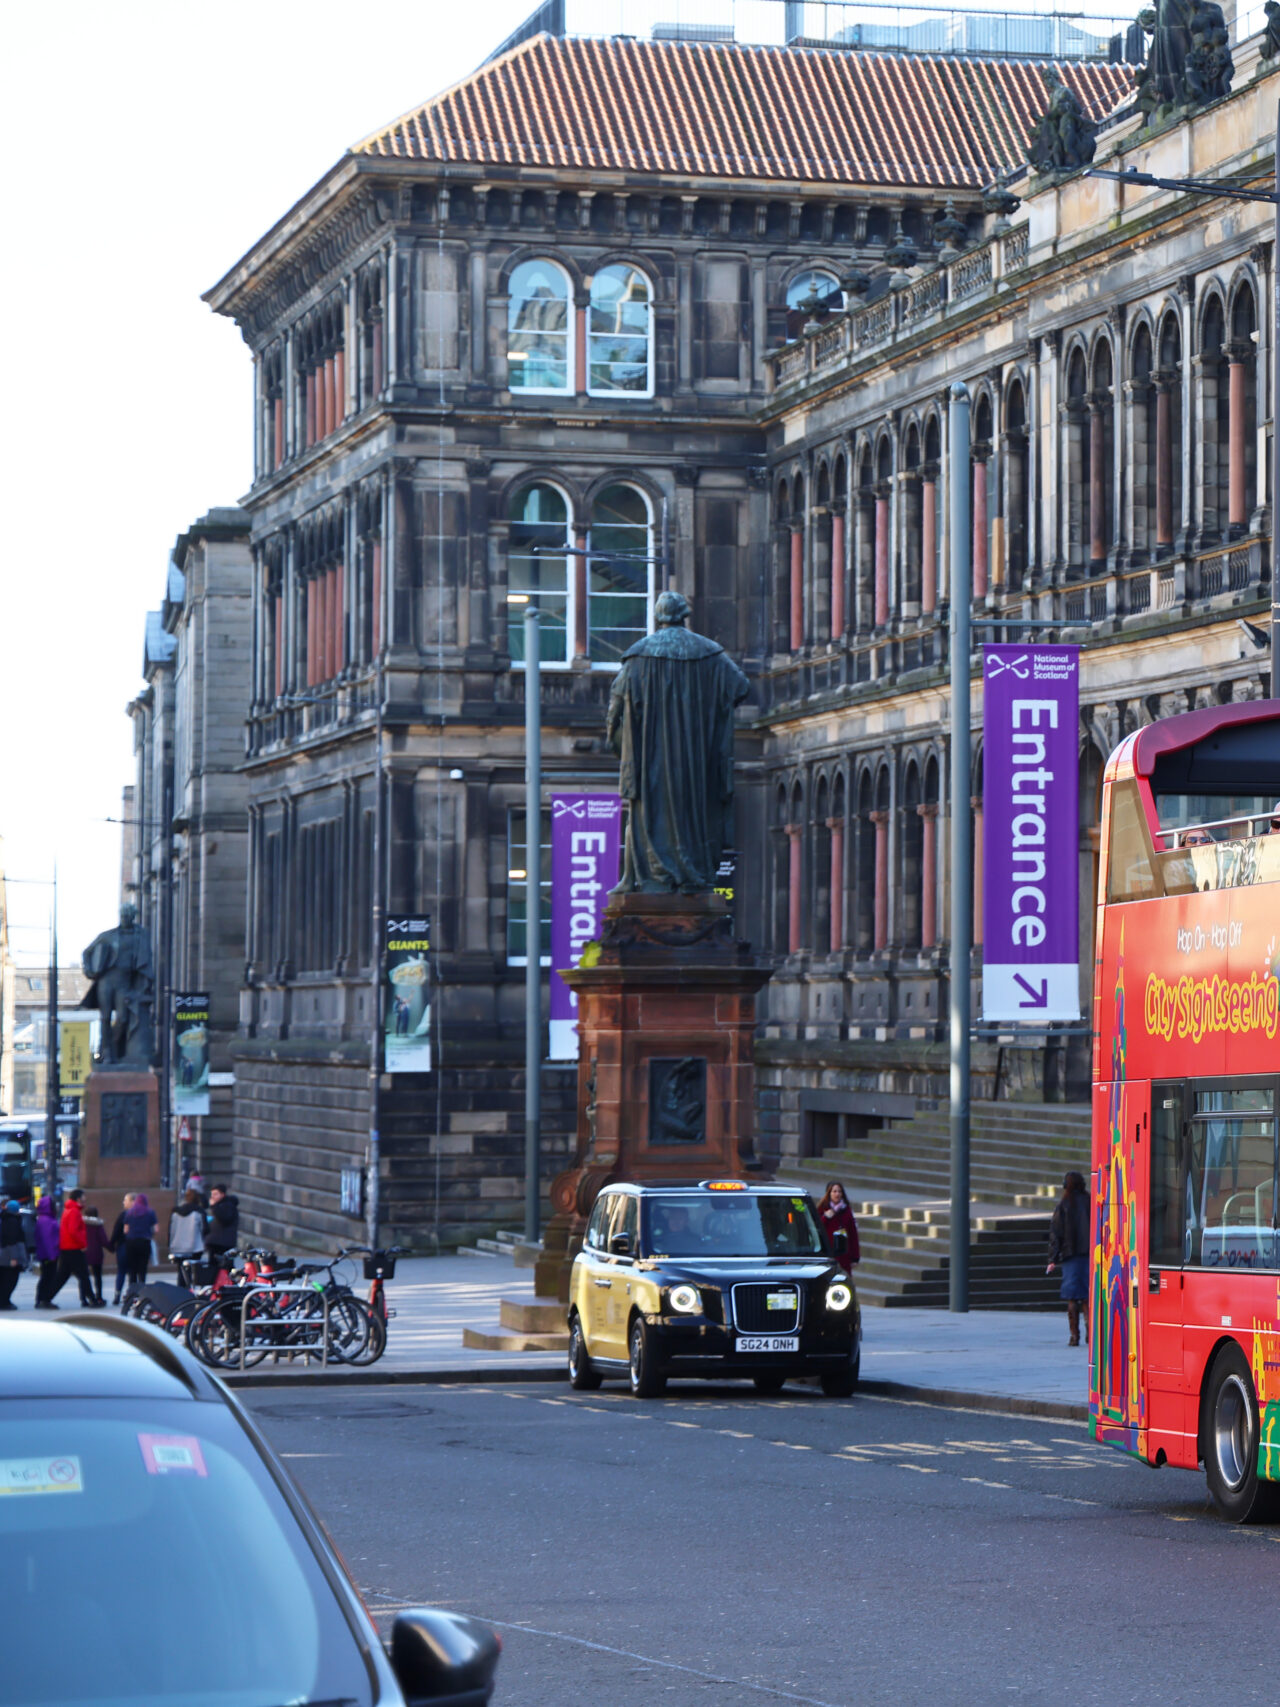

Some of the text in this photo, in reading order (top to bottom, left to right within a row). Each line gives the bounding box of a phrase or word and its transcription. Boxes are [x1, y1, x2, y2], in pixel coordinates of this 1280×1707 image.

[1033, 654, 1069, 663] National
[1033, 662, 1076, 671] Museum of
[1033, 671, 1069, 680] Scotland
[1011, 699, 1059, 947] Entrance
[569, 831, 607, 1008] Entra
[1177, 926, 1193, 955] Hop
[1194, 924, 1206, 951] On
[1211, 924, 1228, 951] Hop
[1228, 921, 1243, 947] Off
[388, 940, 430, 950] GIANTS
[176, 1011, 209, 1021] GIANTS
[740, 1339, 769, 1350] SG24
